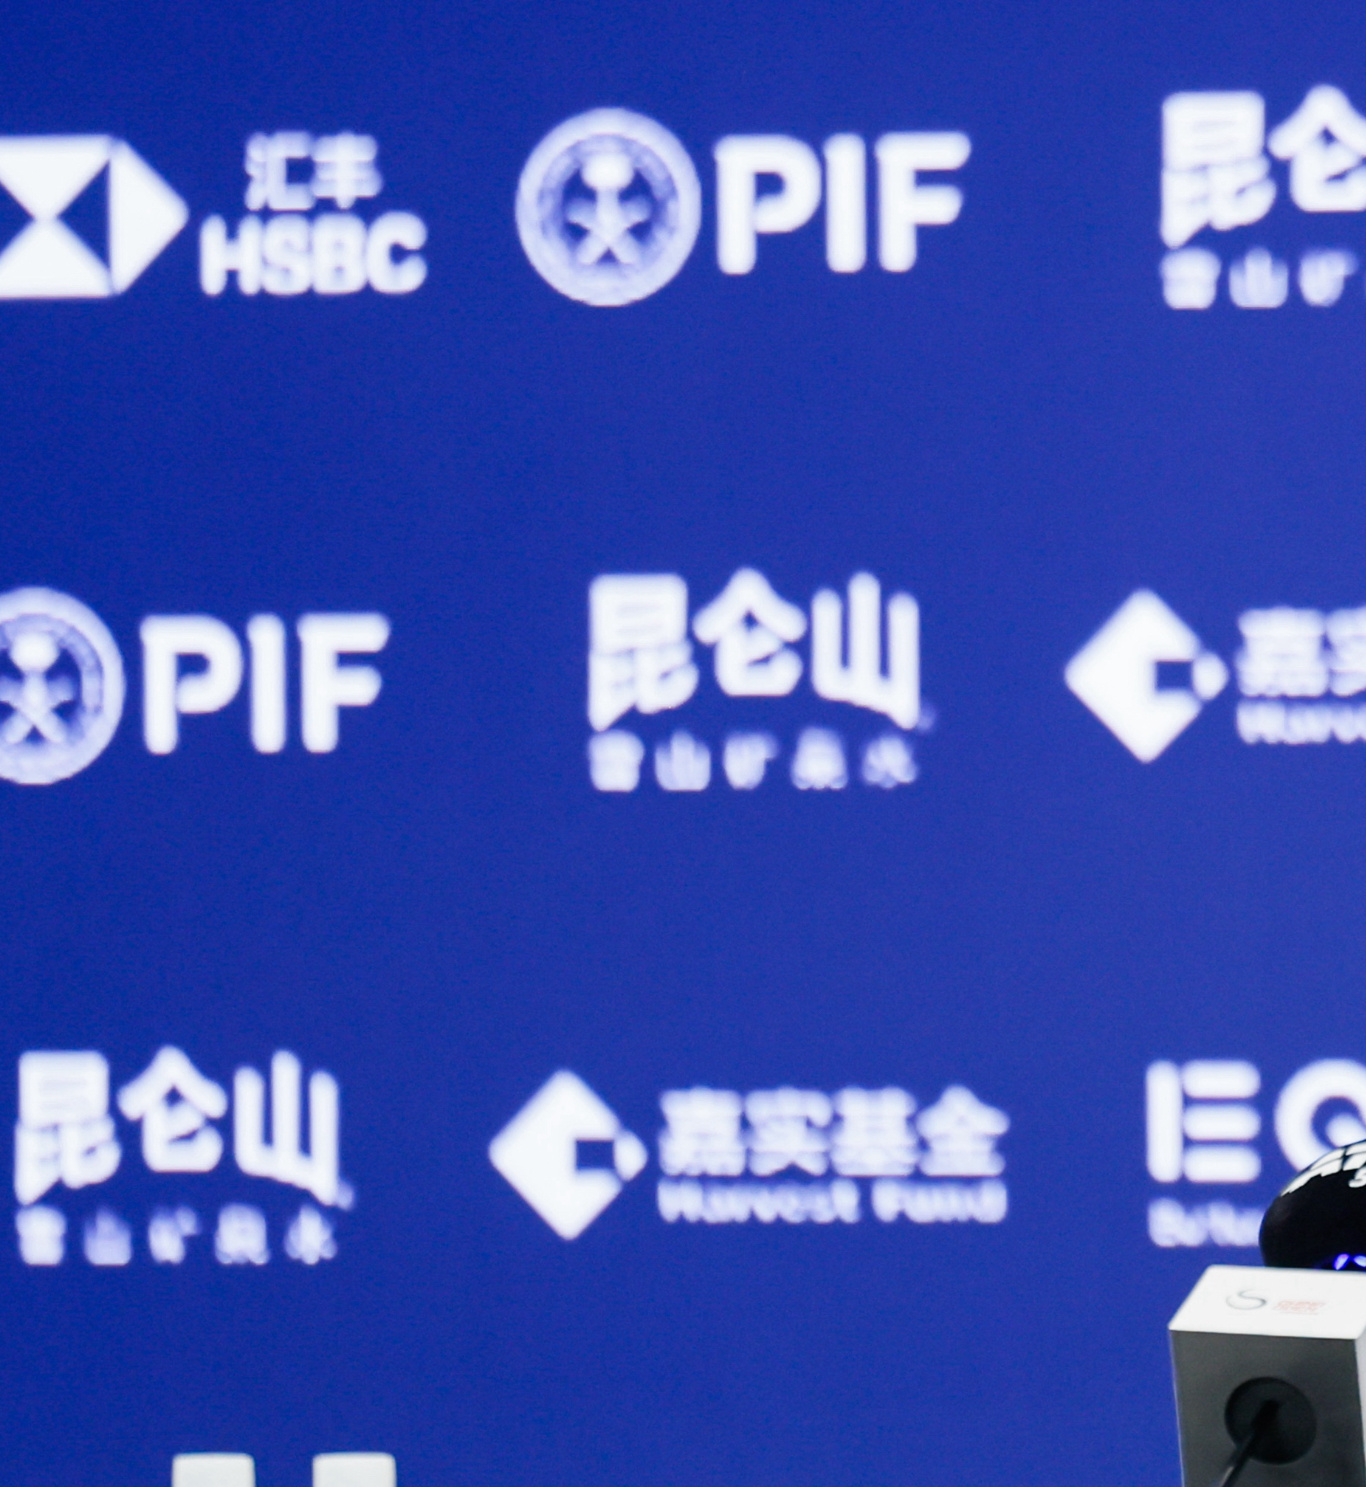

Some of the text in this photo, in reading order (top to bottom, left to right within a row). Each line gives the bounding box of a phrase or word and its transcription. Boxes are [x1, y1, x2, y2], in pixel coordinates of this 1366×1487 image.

[246, 134, 380, 210] 汇丰
[715, 133, 970, 275] PIF
[201, 213, 426, 295] HSBC
[141, 615, 390, 754] PIF
[588, 570, 920, 731] 昆仑山
[15, 1047, 352, 1206] 昆仑山
[659, 1088, 1008, 1177] 嘉实基金
